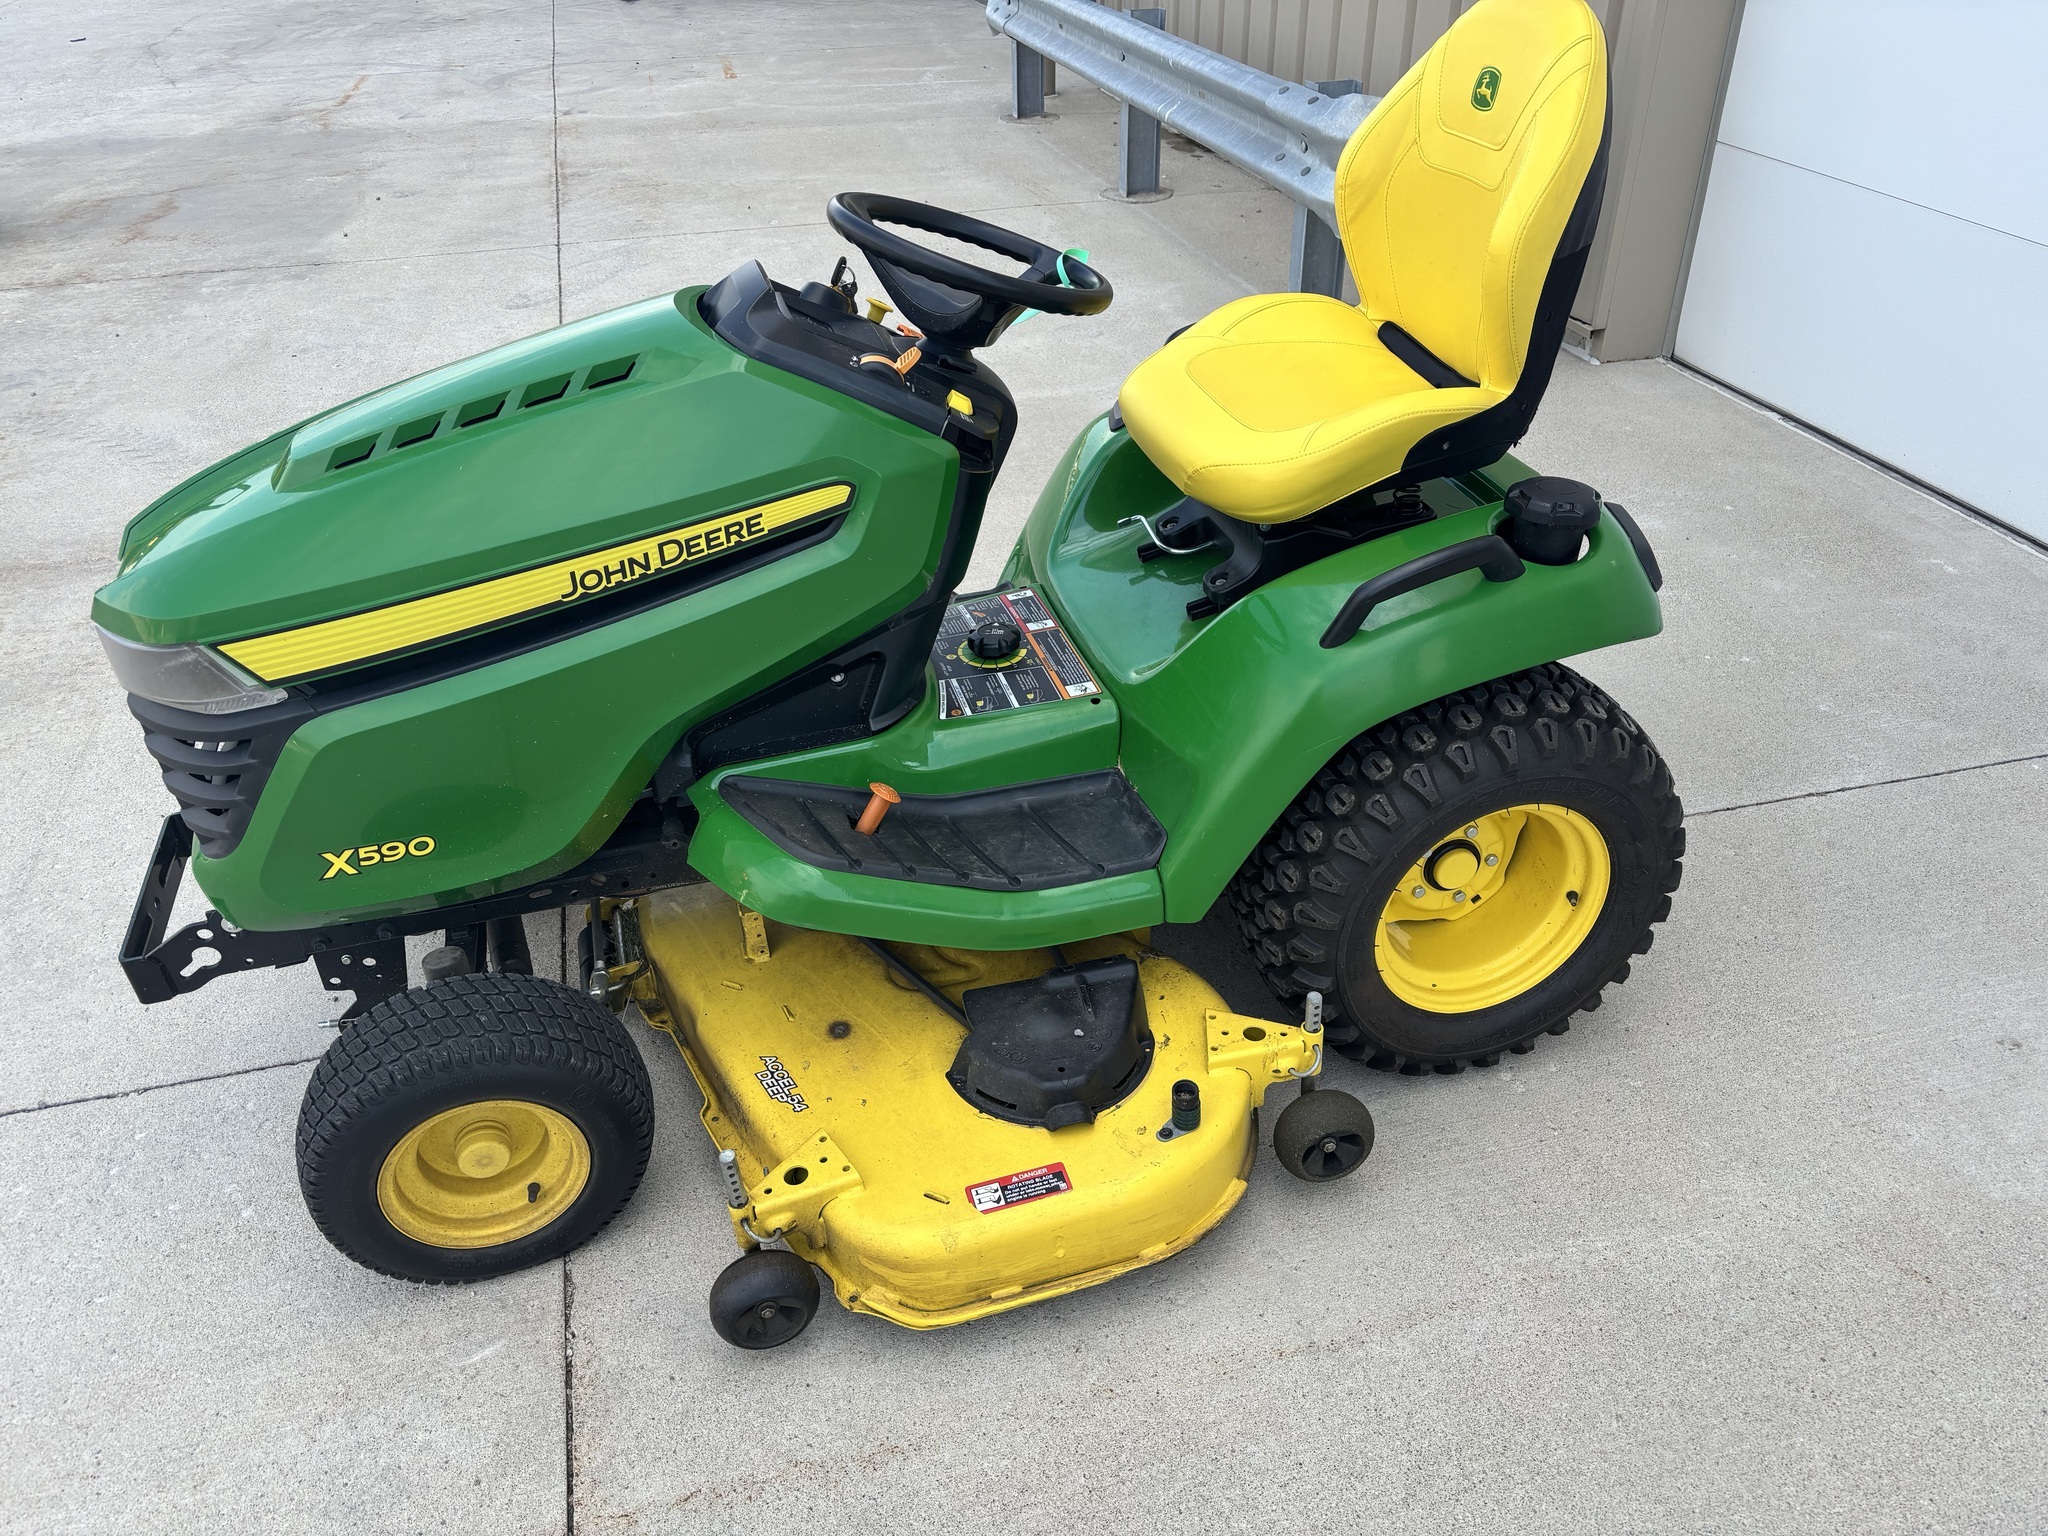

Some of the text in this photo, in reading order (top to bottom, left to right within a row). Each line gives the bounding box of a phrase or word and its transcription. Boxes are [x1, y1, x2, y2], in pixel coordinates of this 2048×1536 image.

[560, 512, 766, 600] JOHN DEERE
[318, 835, 437, 881] X590
[754, 1069, 789, 1102] DEEP
[759, 1055, 798, 1095] ACCEL
[1007, 1174, 1053, 1190] ROTATING BLADE
[1018, 1167, 1048, 1180] DANGER
